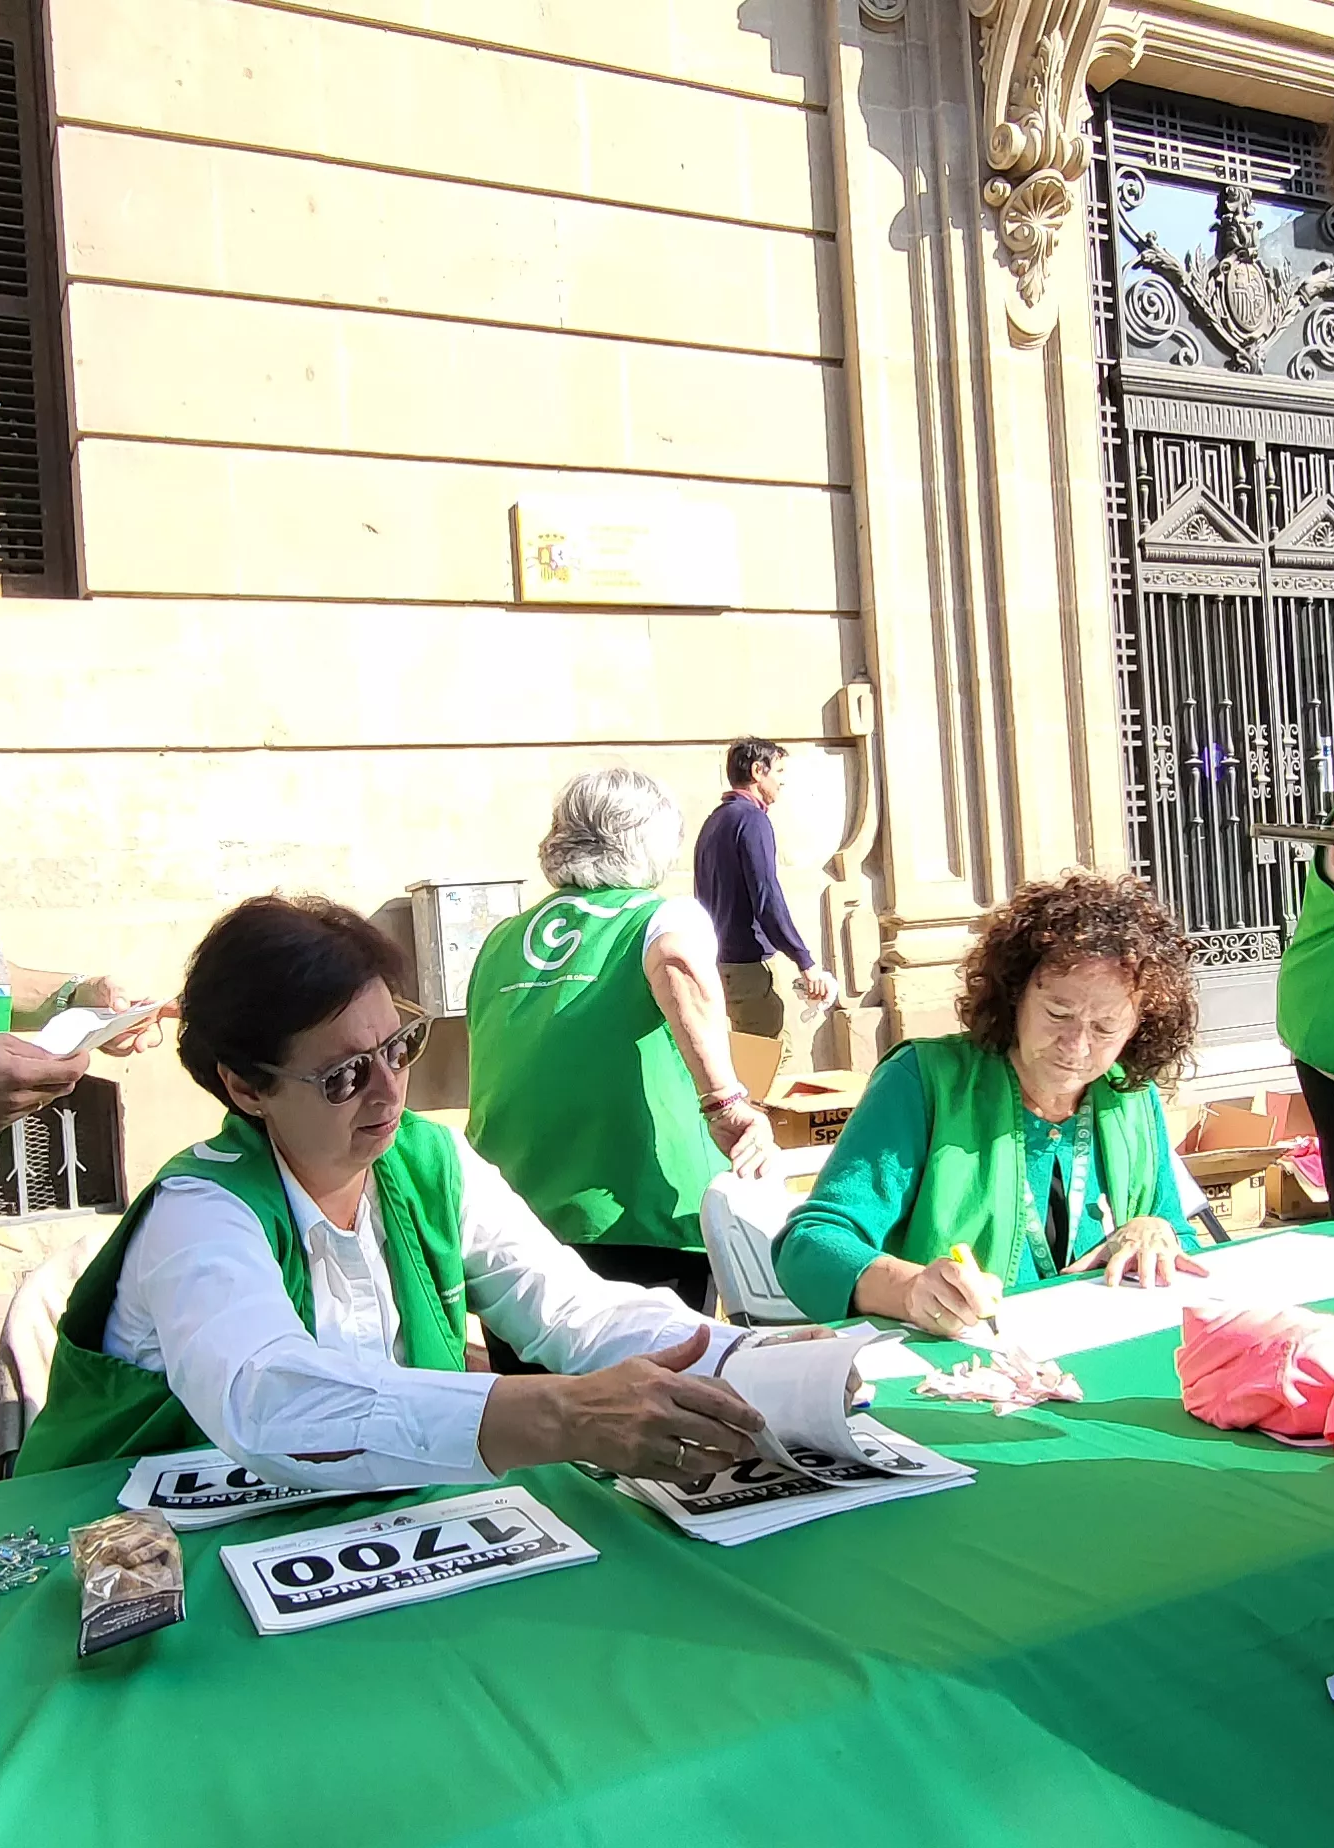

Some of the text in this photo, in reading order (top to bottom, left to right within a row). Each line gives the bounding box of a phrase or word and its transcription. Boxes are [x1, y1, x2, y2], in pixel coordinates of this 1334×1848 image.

[271, 1516, 527, 1588] 1700
[435, 1541, 541, 1571] CONTRA
[385, 1568, 464, 1591] HUESCA
[402, 1564, 433, 1578] EL
